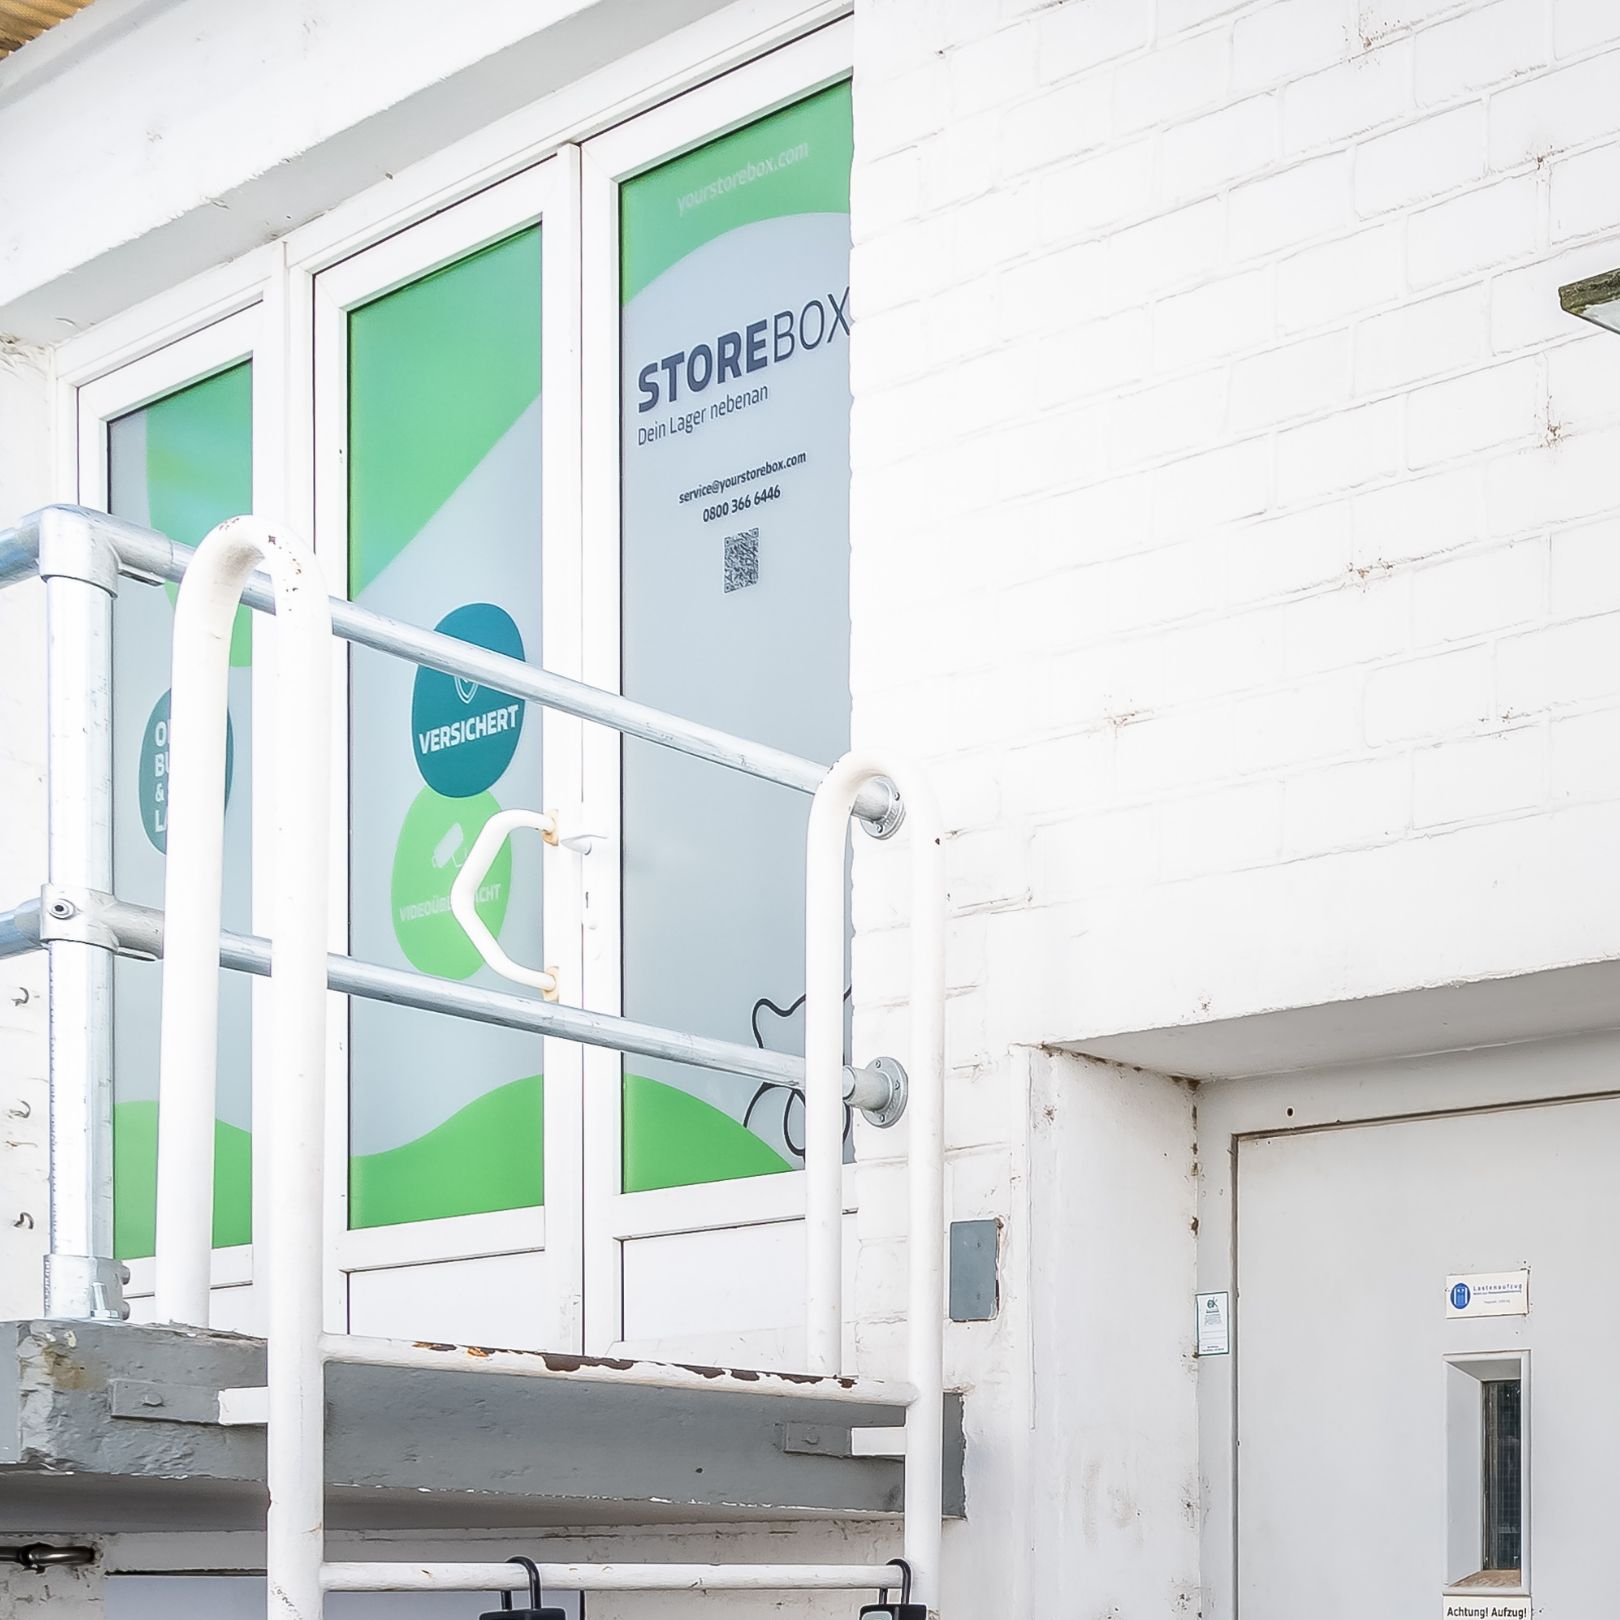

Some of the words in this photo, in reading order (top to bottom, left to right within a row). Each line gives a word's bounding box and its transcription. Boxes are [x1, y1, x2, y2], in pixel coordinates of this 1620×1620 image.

[678, 140, 809, 217] yourstorebox.com
[638, 286, 850, 413] STOREBOX
[638, 420, 666, 446] Dein
[669, 405, 705, 433] Lager
[710, 384, 768, 420] nebenan
[679, 452, 807, 504] service@yourstorebox.com
[703, 502, 729, 522] 0800
[731, 494, 751, 513] 366
[754, 484, 781, 505] 6446
[418, 704, 519, 754] VERSICHERT
[1447, 1607, 1488, 1619] Achtung!
[1491, 1607, 1527, 1620] Aufzug!
